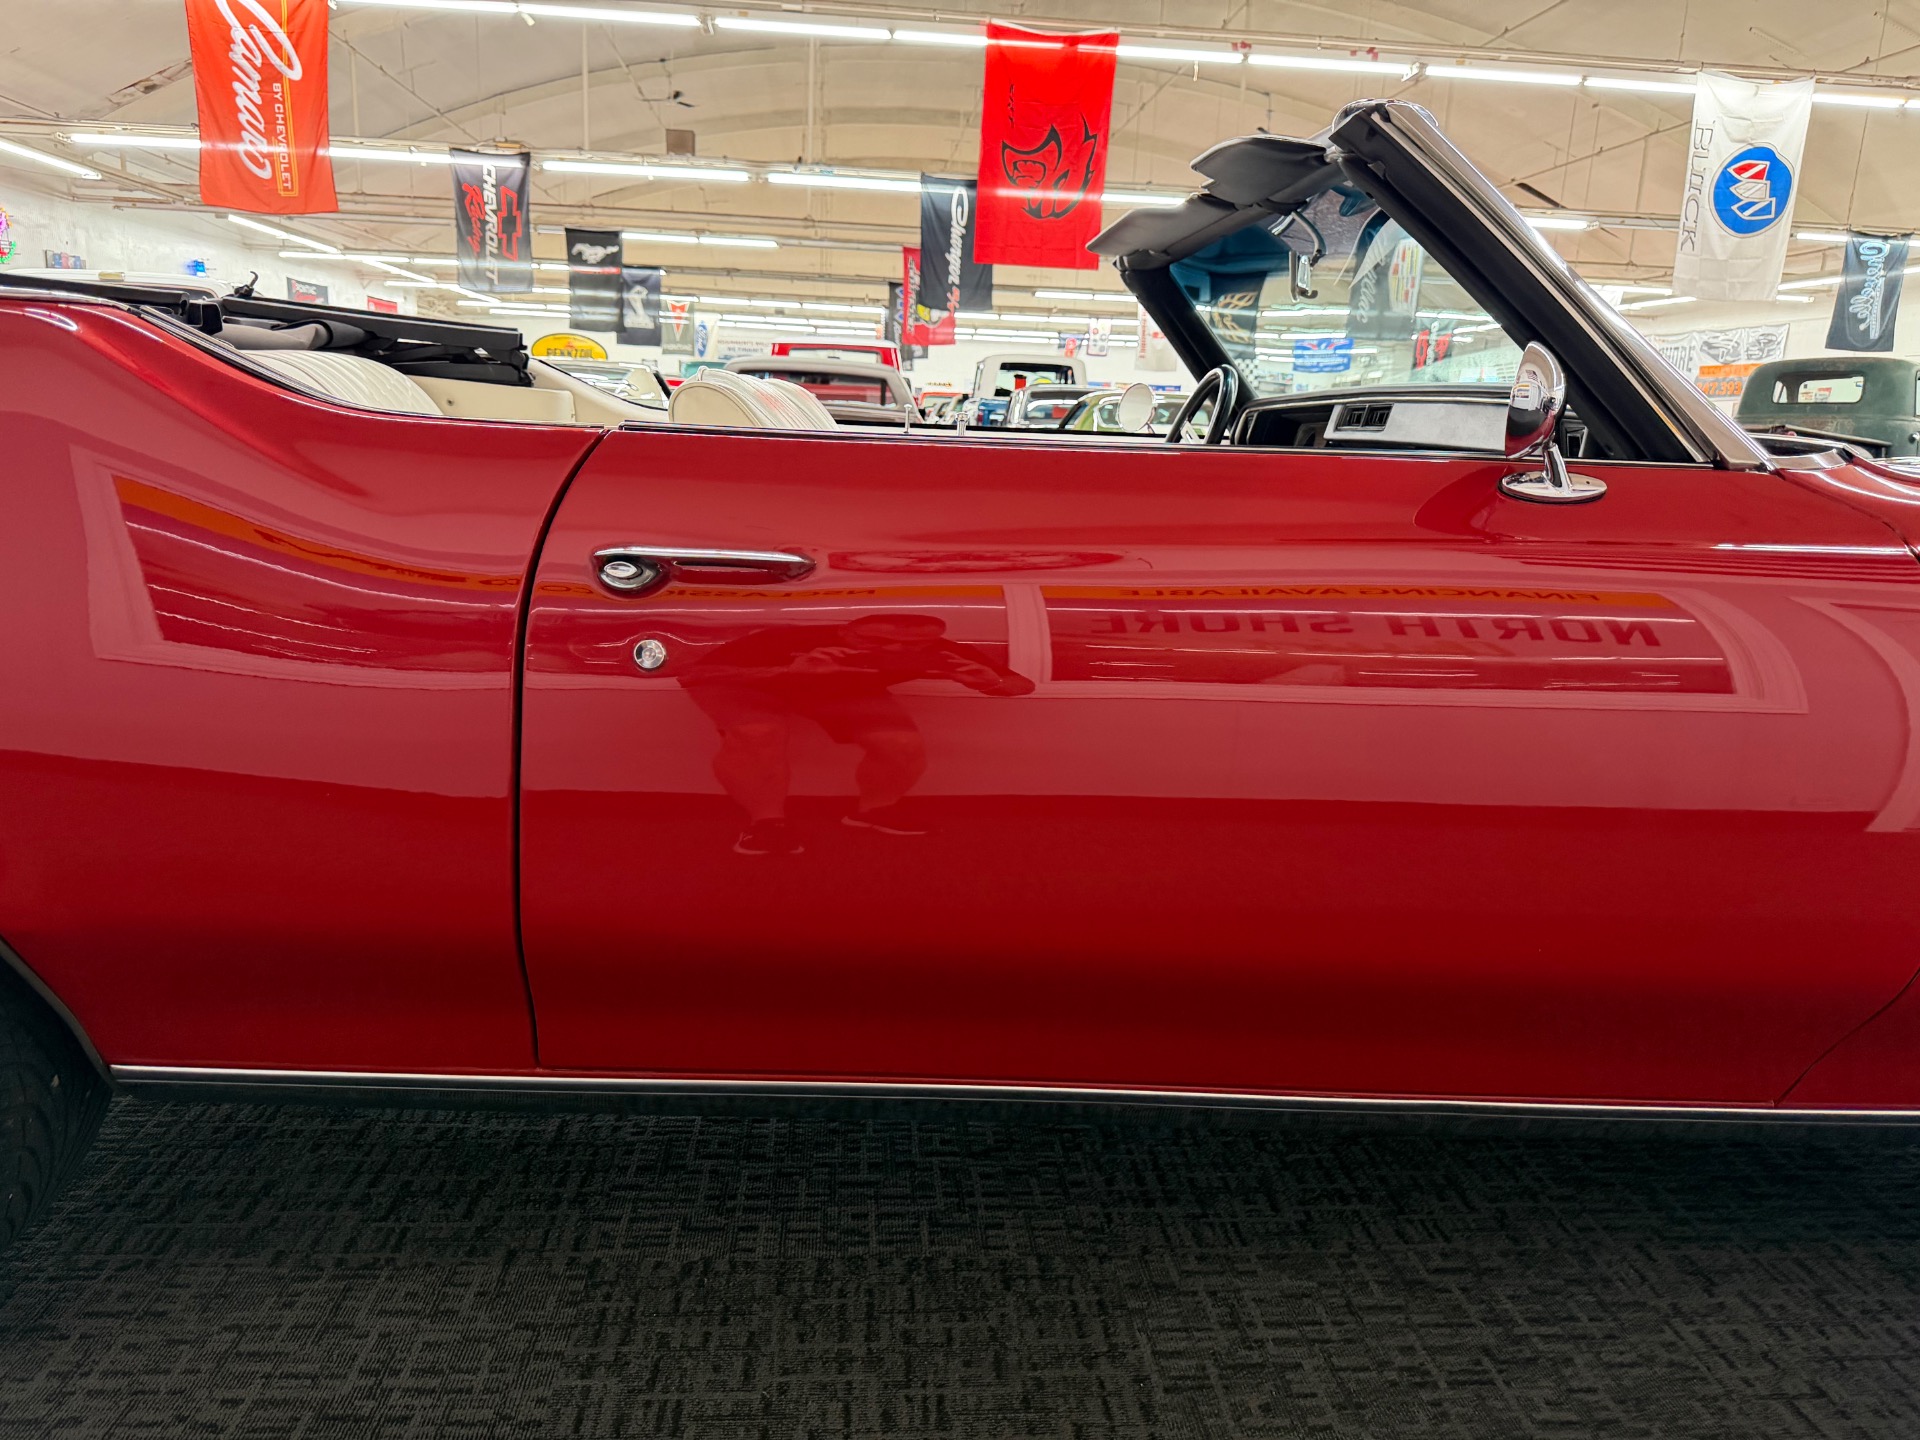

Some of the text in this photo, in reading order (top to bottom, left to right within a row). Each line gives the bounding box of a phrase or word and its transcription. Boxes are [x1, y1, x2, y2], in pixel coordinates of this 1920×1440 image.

[214, 0, 302, 180] Camaro
[272, 82, 292, 190] BY CHEVROLET
[461, 182, 486, 257] Racing
[482, 164, 499, 285] CHEVROLET
[944, 186, 969, 285] Charger
[1680, 119, 1715, 252] BUICK
[1848, 240, 1891, 331] Chevelle
